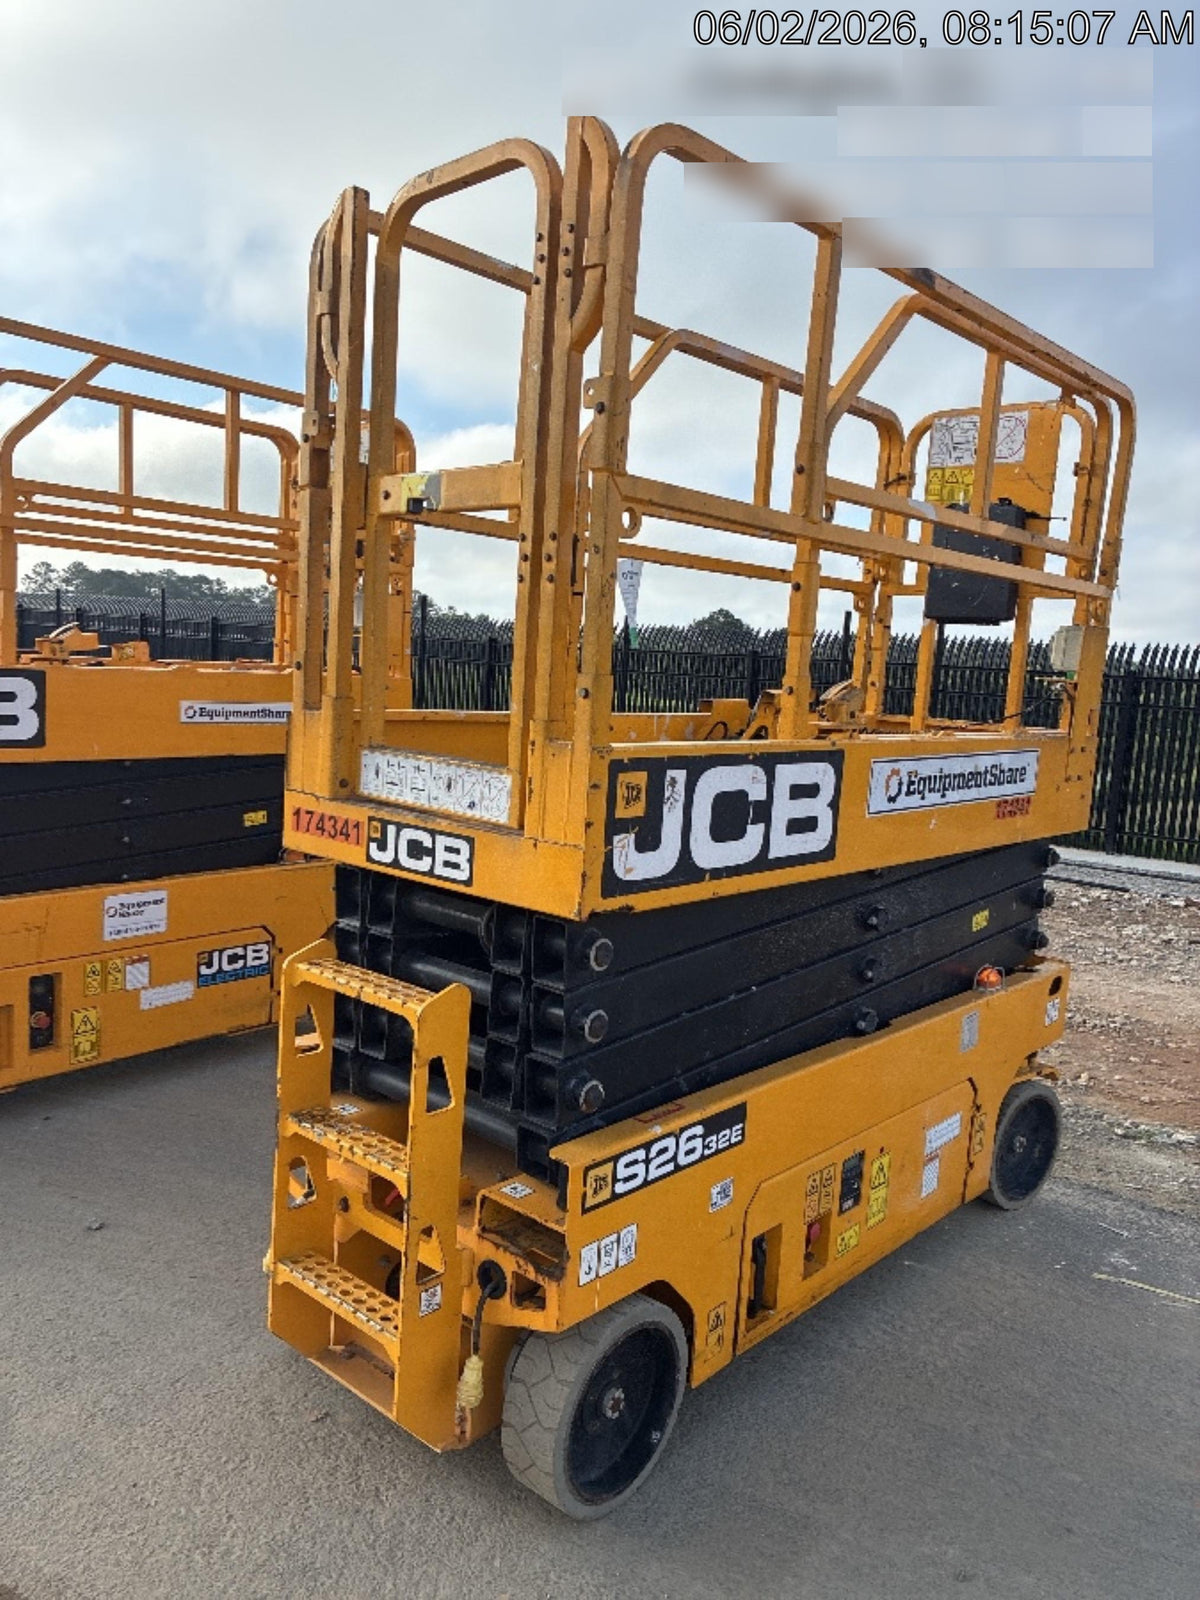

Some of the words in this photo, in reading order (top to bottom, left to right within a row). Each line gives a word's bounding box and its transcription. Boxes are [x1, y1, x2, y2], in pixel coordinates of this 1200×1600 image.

[904, 763, 1028, 800] EquipmentShare
[292, 806, 361, 846] 174341
[612, 762, 837, 881] JCB
[369, 824, 471, 881] JCB
[199, 943, 269, 975] JCB
[199, 964, 268, 986] ELECTRIC
